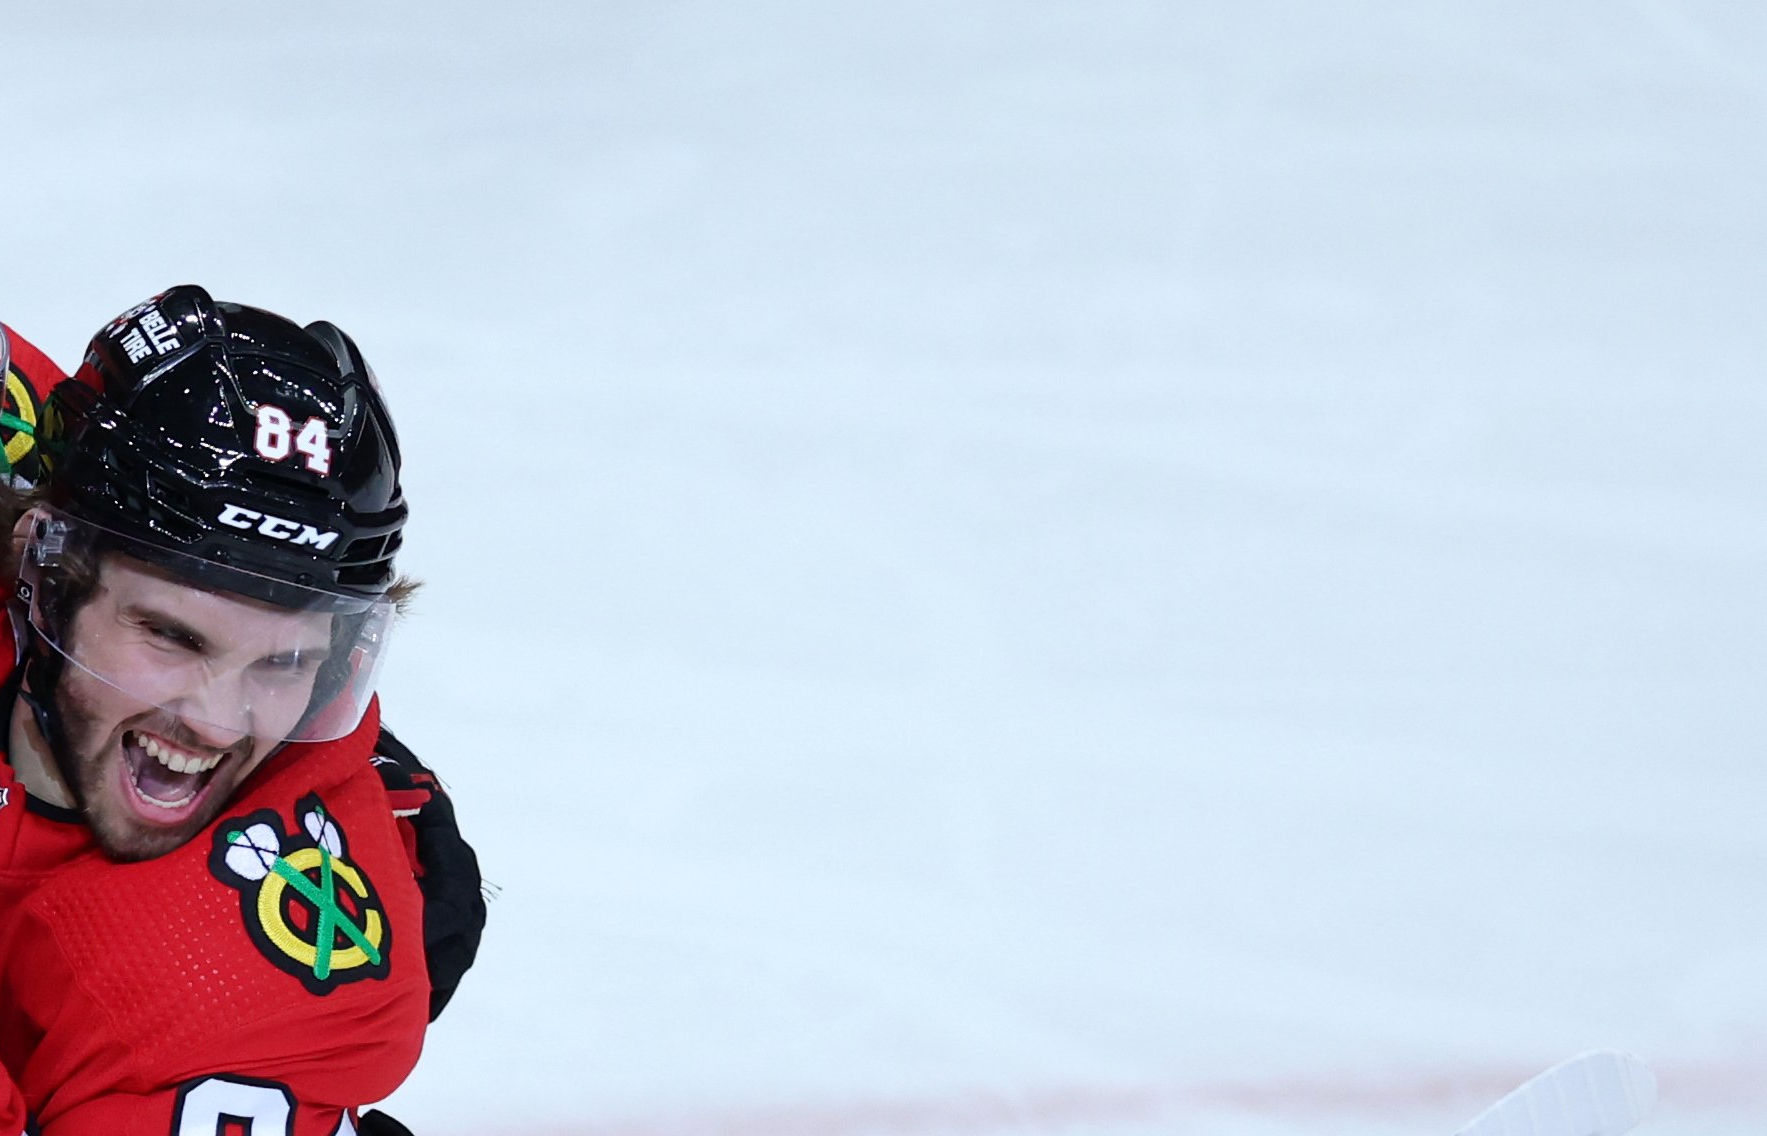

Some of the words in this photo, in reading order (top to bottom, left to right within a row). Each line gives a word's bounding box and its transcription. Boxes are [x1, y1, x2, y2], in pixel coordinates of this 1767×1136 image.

[120, 327, 153, 364] TIRE
[138, 309, 181, 355] BELLE
[253, 403, 333, 476] 84
[217, 503, 339, 550] CCM
